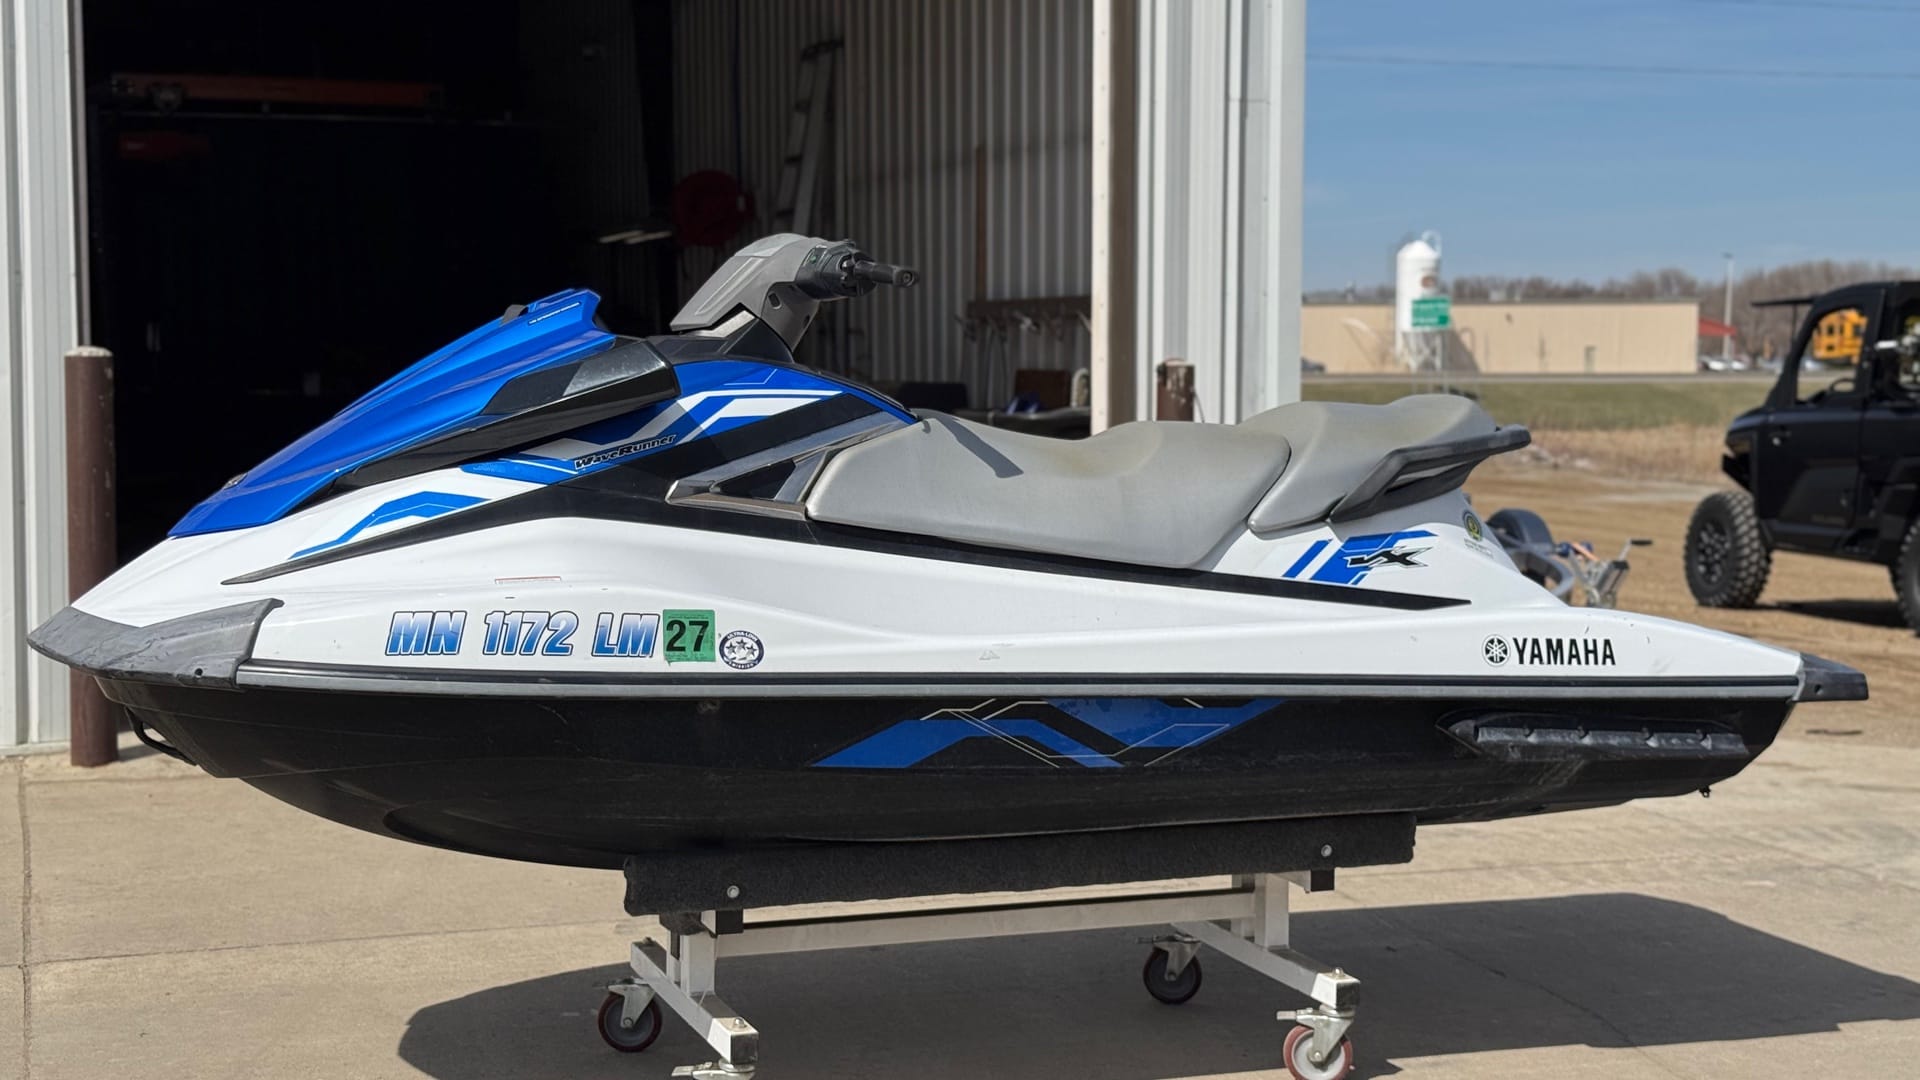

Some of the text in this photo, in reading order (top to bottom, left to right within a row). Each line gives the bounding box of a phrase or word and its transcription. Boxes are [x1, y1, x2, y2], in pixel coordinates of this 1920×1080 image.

[574, 434, 677, 469] WaveRunner
[385, 611, 467, 656] MN
[482, 611, 579, 656] 1172
[591, 612, 660, 657] LM
[665, 619, 709, 652] 27
[1512, 637, 1616, 665] YAMAHA
